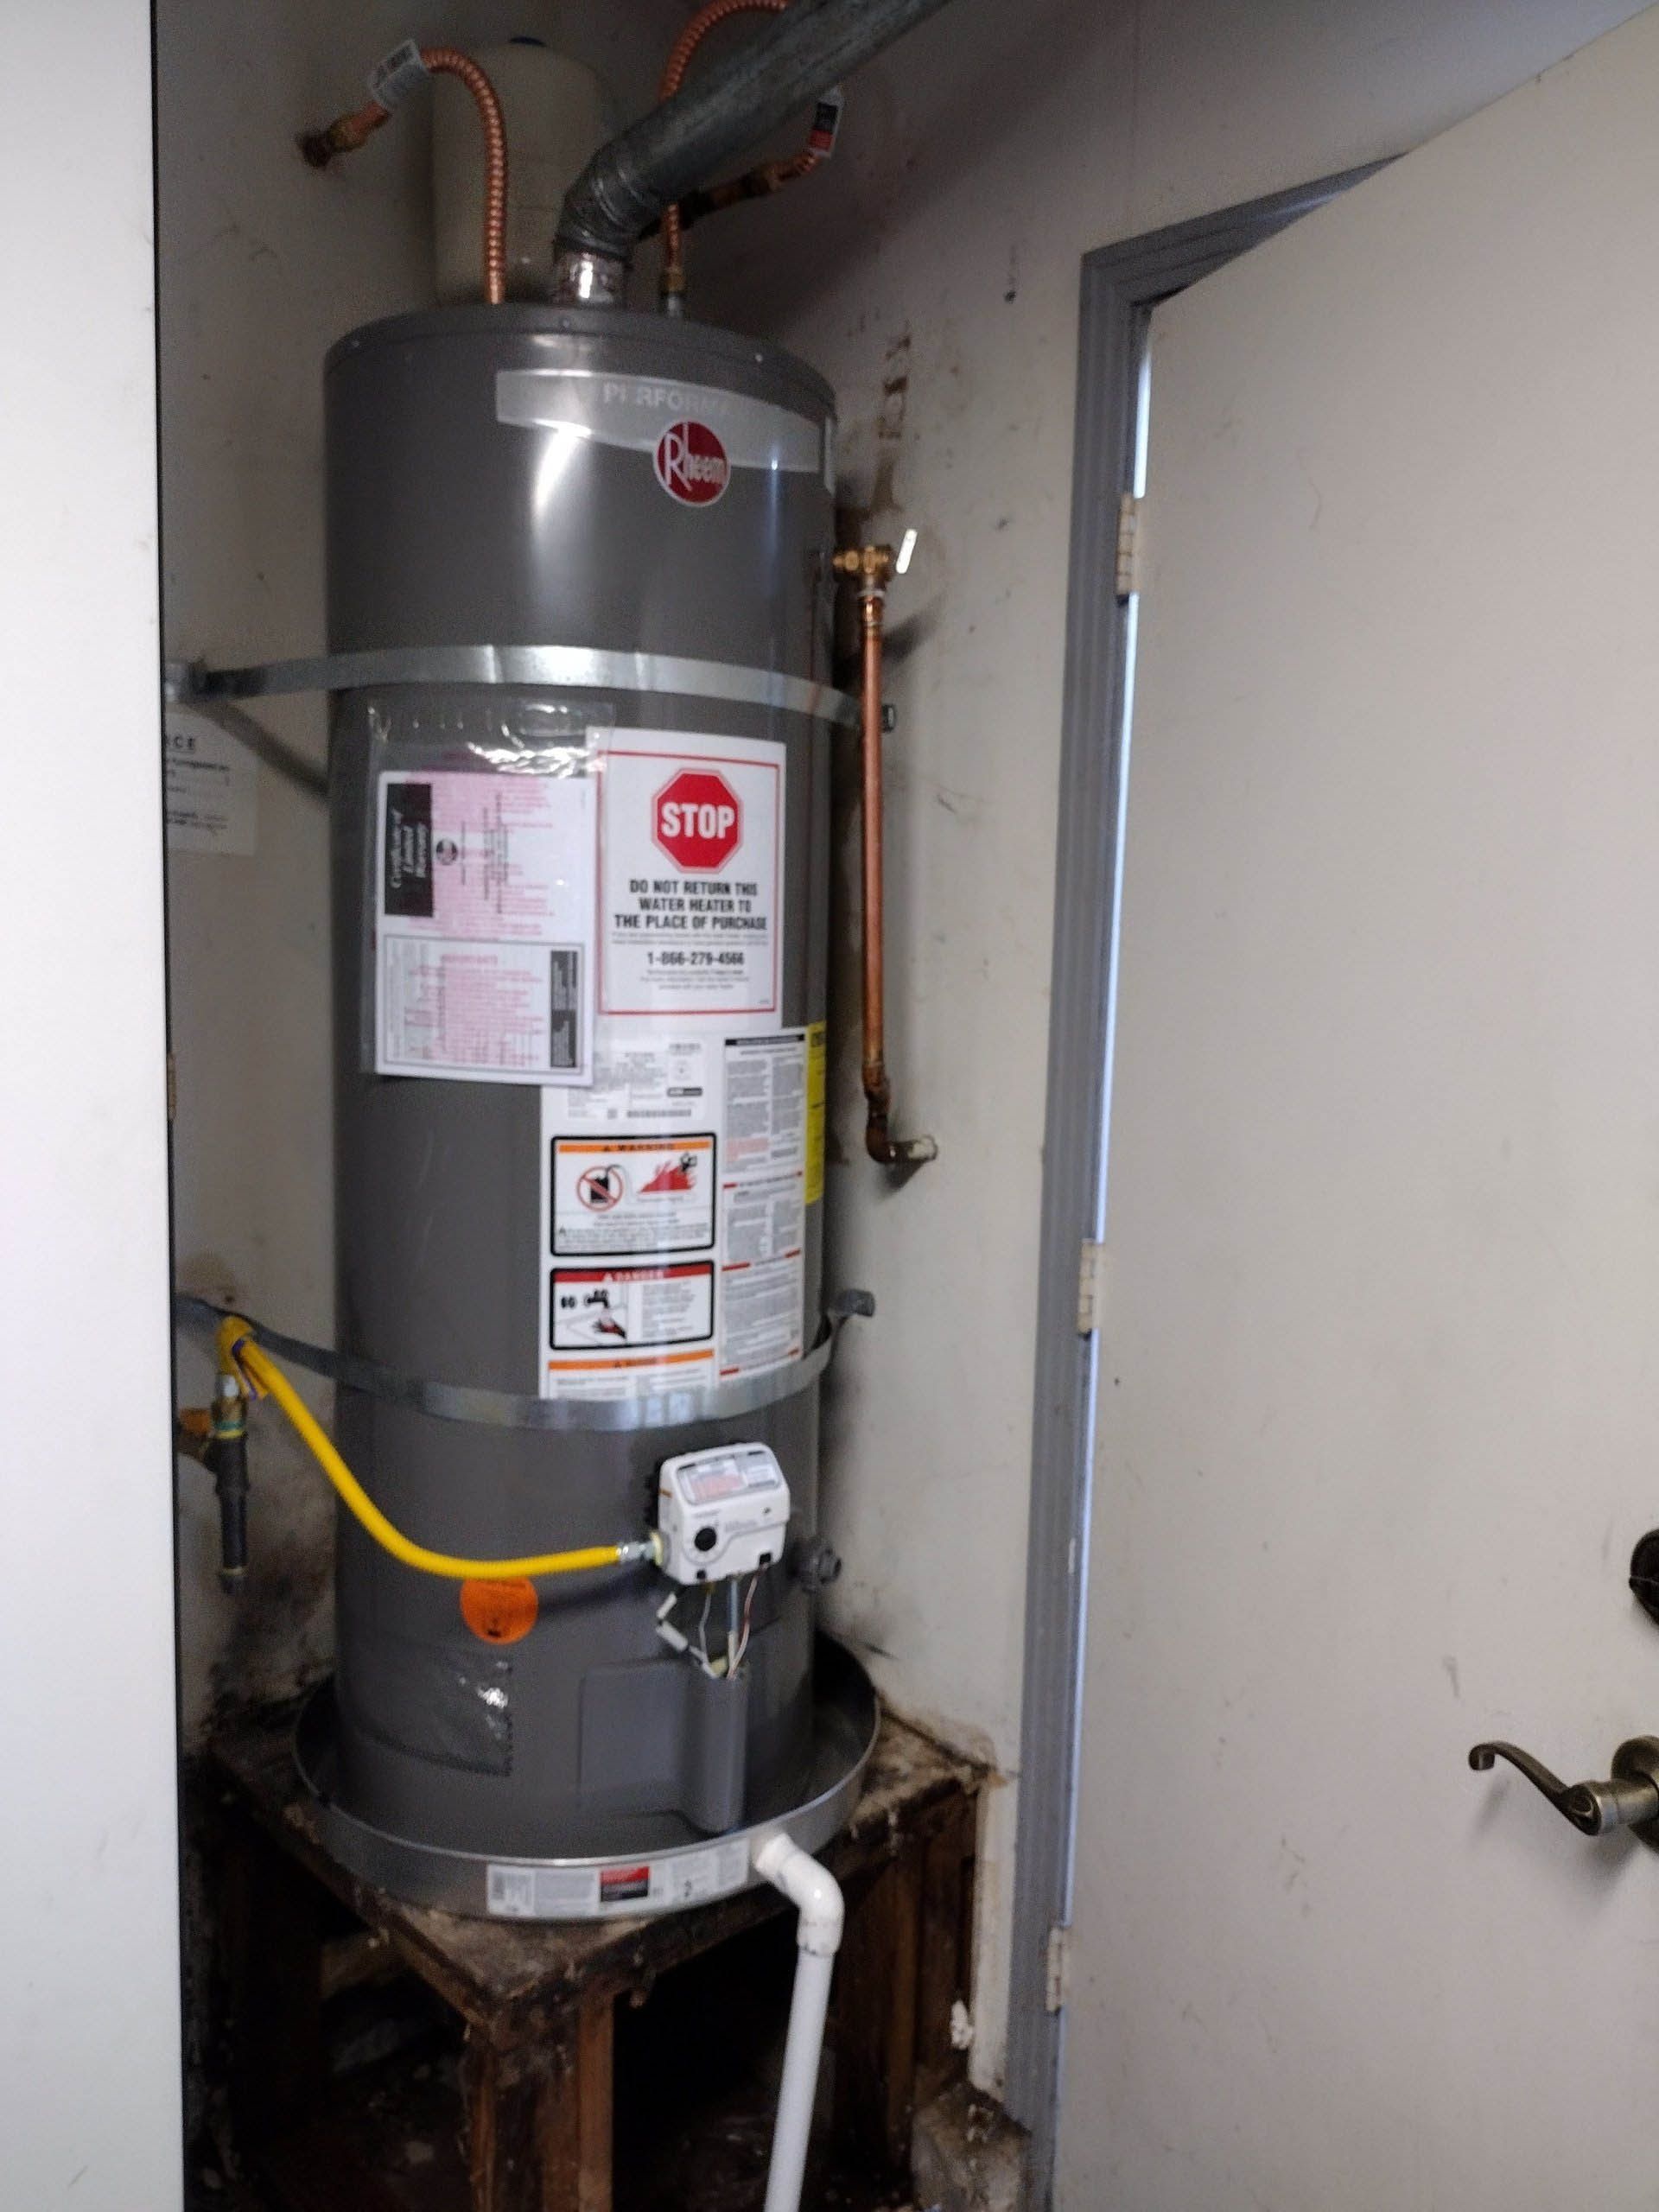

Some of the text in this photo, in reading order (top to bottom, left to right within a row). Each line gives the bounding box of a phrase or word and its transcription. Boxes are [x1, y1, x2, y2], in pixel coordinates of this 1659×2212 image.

[663, 422, 727, 492] Rheem
[661, 802, 735, 839] STOP
[629, 880, 758, 896] DO NOT RETURN THIS
[639, 897, 752, 913] WATER HEATER TO
[614, 913, 767, 931] THE PLACE OF PURCHASE
